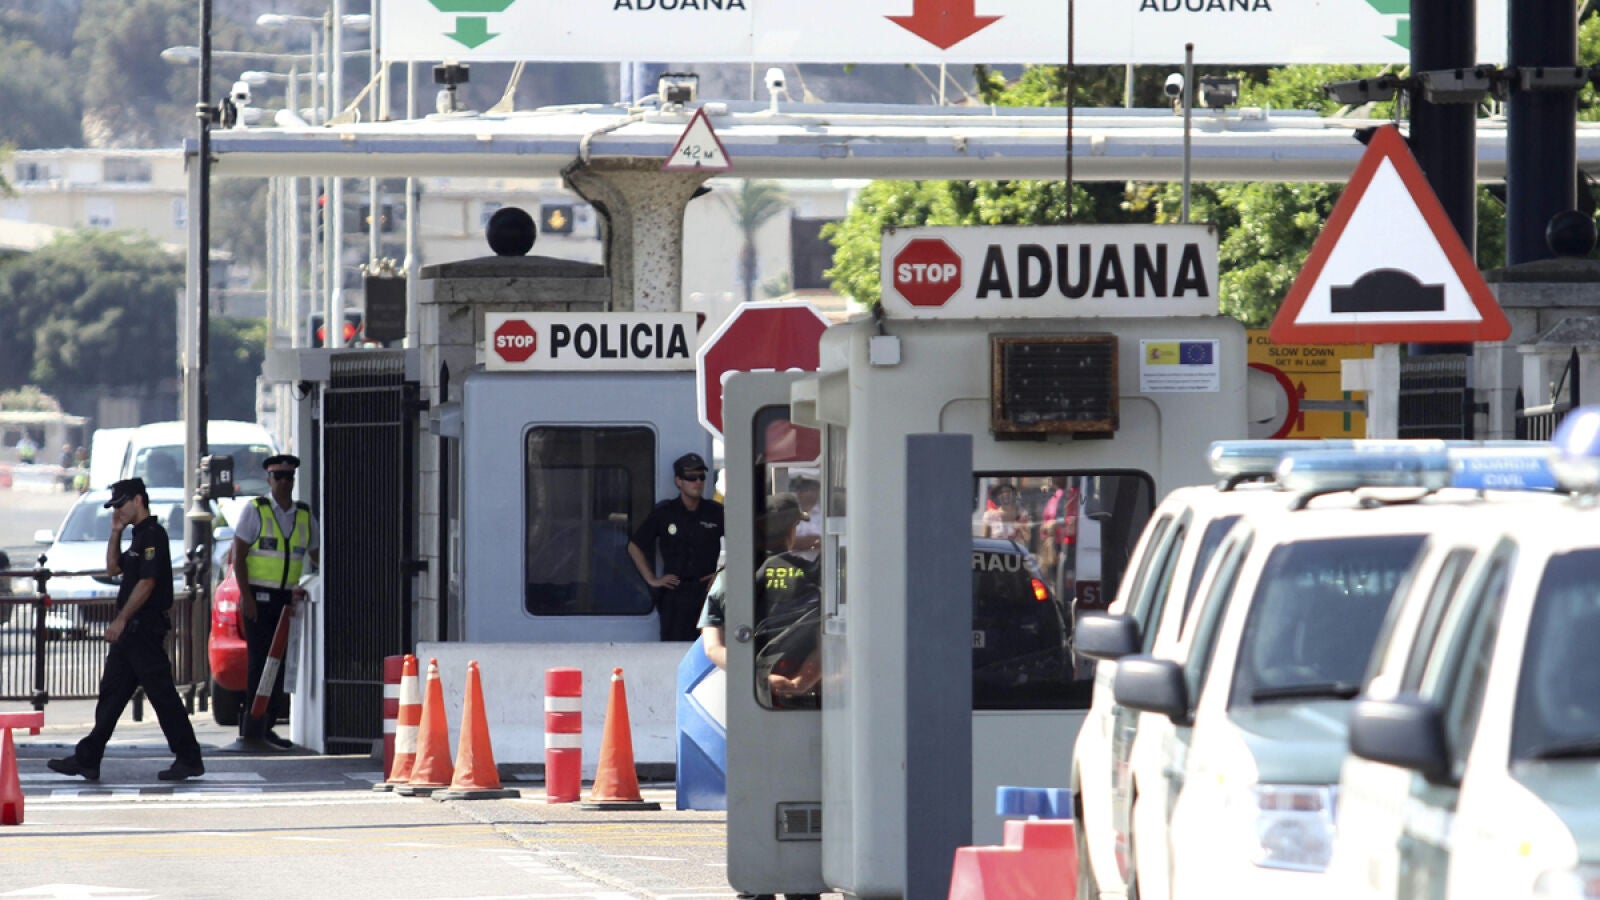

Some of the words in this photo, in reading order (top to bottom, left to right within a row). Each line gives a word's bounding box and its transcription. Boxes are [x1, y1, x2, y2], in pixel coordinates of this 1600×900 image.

[613, 0, 746, 10] ADUANA
[1139, 0, 1273, 12] ADUANA
[898, 263, 957, 283] STOP
[976, 243, 1210, 299] ADUANA
[496, 335, 534, 348] STOP
[550, 323, 689, 359] POLICIA
[1268, 347, 1299, 357] SLOW
[1303, 347, 1335, 357] DOWN
[1307, 359, 1328, 367] LANE
